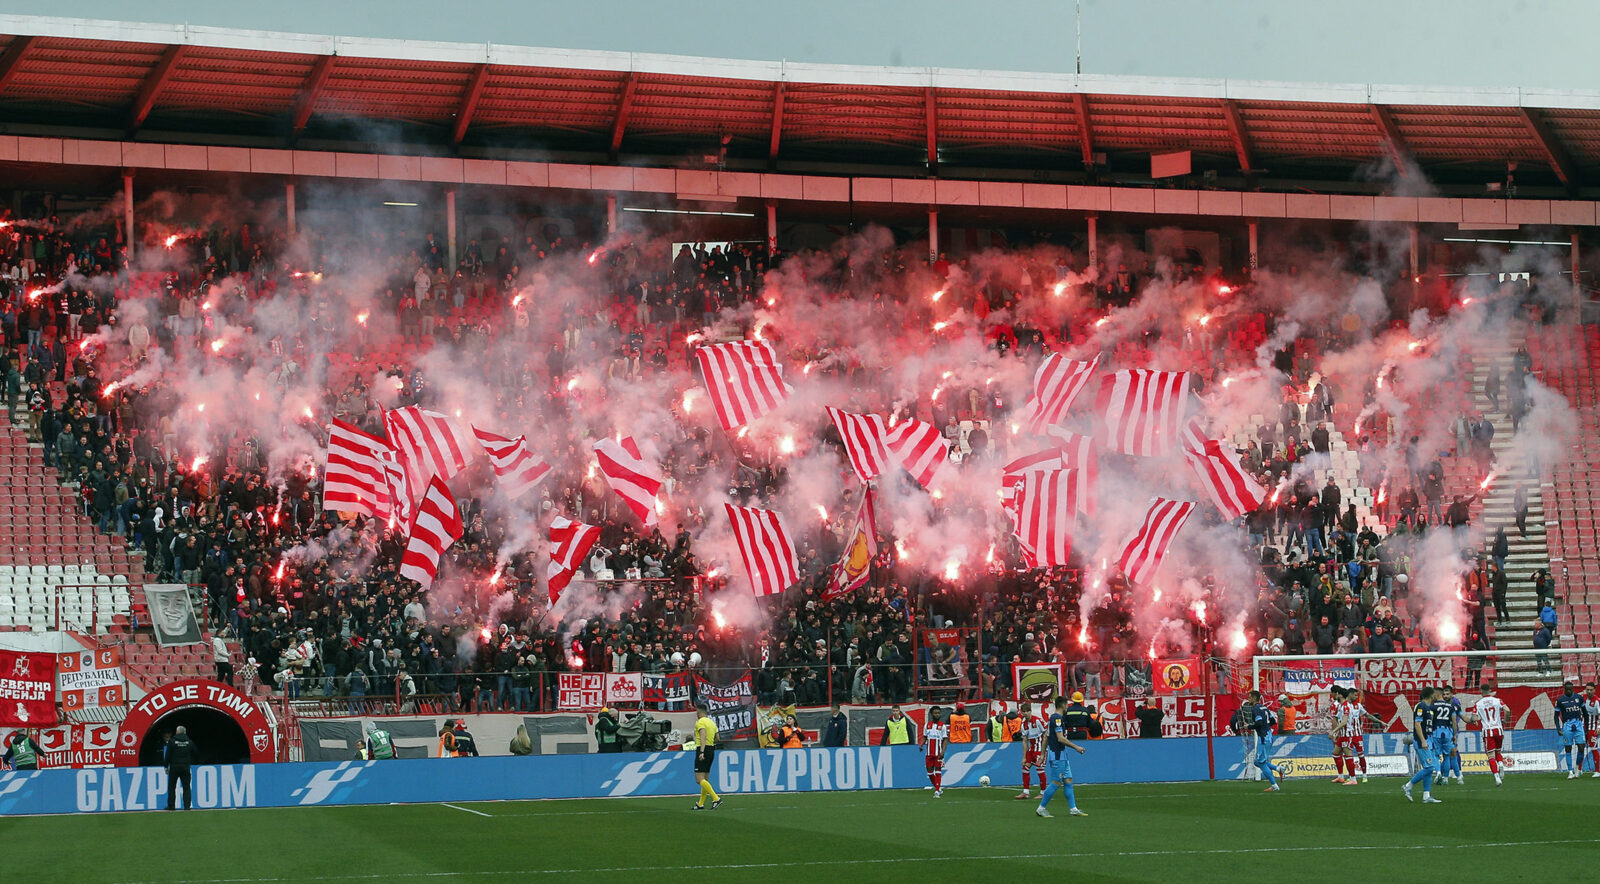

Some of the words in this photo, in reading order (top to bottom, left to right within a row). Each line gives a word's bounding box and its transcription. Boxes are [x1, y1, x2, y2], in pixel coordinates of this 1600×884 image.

[1365, 657, 1446, 678] CRAZY
[0, 678, 52, 692] ЕВЕРНА
[61, 668, 120, 687] РЕПУБЛИКА
[75, 679, 106, 689] СРПСКА
[138, 693, 168, 716] ТО
[172, 684, 199, 702] ЈЕ
[206, 685, 254, 719] ТИМ!
[1437, 707, 1450, 720] 22
[1484, 706, 1496, 722] 17
[46, 750, 111, 766] НИШЛИЈЕ
[718, 746, 893, 793] GAZPROM
[1297, 763, 1338, 771] MOZZAR
